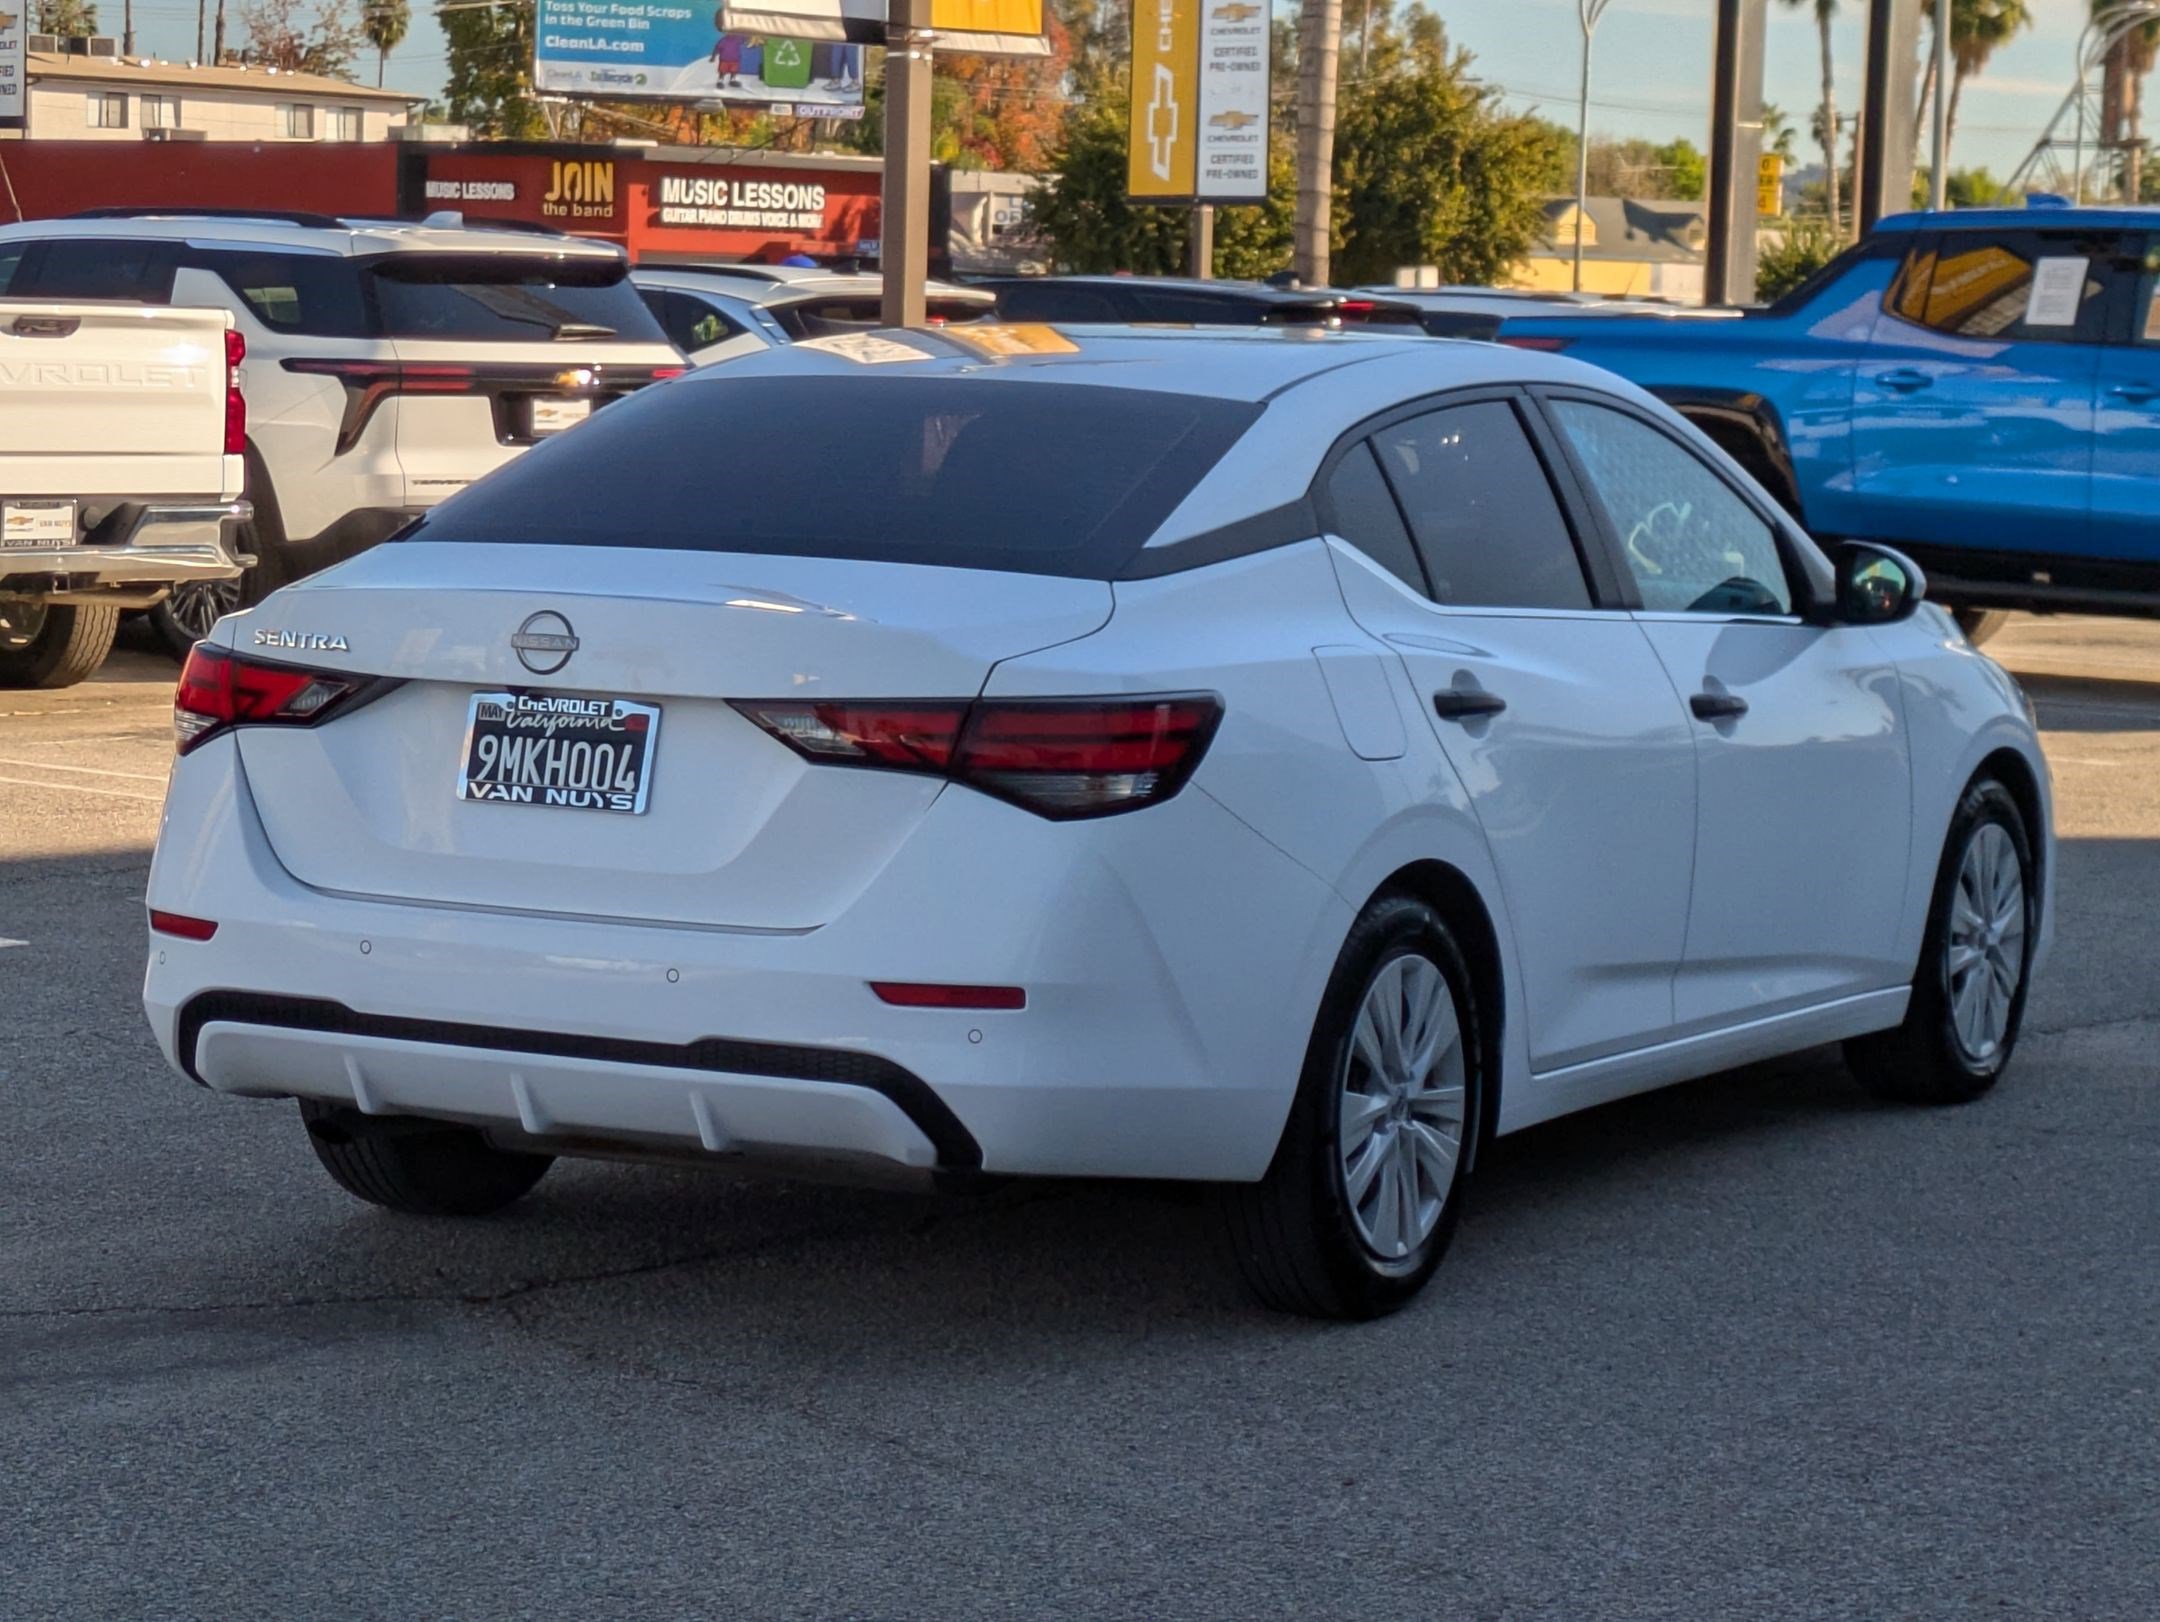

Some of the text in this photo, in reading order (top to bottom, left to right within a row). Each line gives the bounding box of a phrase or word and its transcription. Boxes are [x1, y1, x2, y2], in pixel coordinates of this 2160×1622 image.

[545, 1, 692, 19] Toss Your Food Scraps
[560, 14, 583, 26] the
[586, 15, 626, 28] Green
[629, 18, 650, 30] Bin
[1210, 27, 1261, 36] CHEVROLET
[544, 35, 645, 52] CleanLA.com
[1213, 47, 1258, 57] CERTIFIED
[1209, 61, 1261, 72] PRE-OWNED
[1207, 134, 1259, 143] CHEVROLET
[1210, 154, 1255, 165] CERTIFIED
[544, 161, 614, 203] JOIN
[1206, 169, 1259, 180] PRE-OWNED
[425, 180, 515, 201] MUSIC LESSONS
[661, 177, 825, 211] MUSIC LESSONS
[543, 203, 613, 218] the band
[661, 207, 698, 224] GUITAR
[699, 208, 727, 225] PIANO
[761, 210, 789, 227] VOICE
[253, 628, 349, 652] SENTRA
[518, 696, 610, 716] CHEVROLET
[506, 711, 625, 738] California
[475, 734, 635, 793] 9MKH004
[469, 782, 633, 810] VAN NUYS
